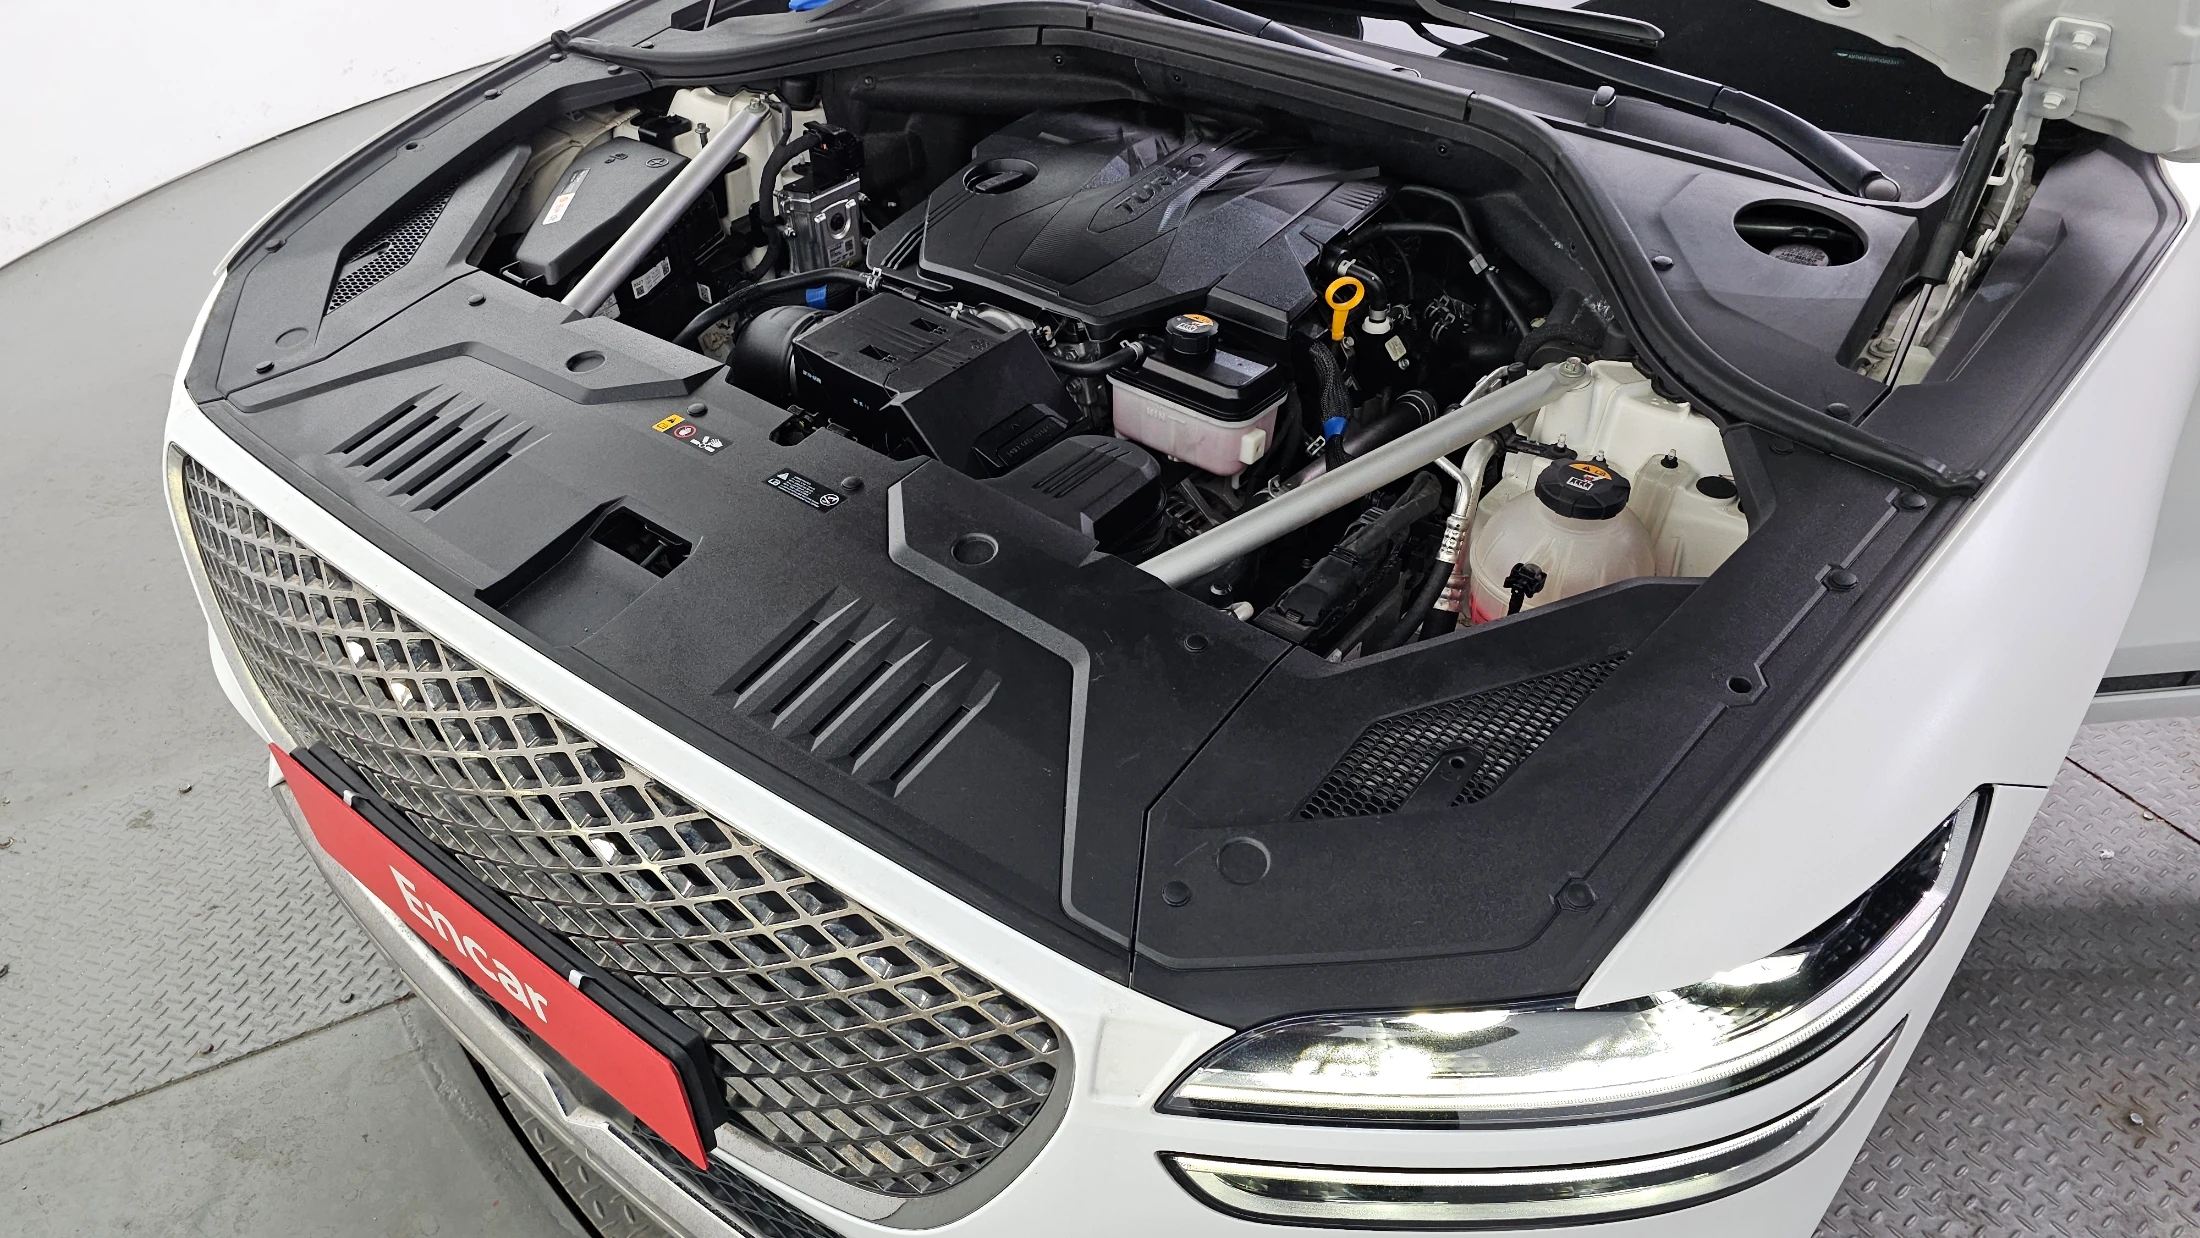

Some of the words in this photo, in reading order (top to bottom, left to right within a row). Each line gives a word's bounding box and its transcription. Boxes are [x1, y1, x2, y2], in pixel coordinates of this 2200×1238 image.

[1114, 153, 1208, 214] TURBO
[1146, 406, 1166, 422] MIN
[389, 864, 548, 1024] Encar
